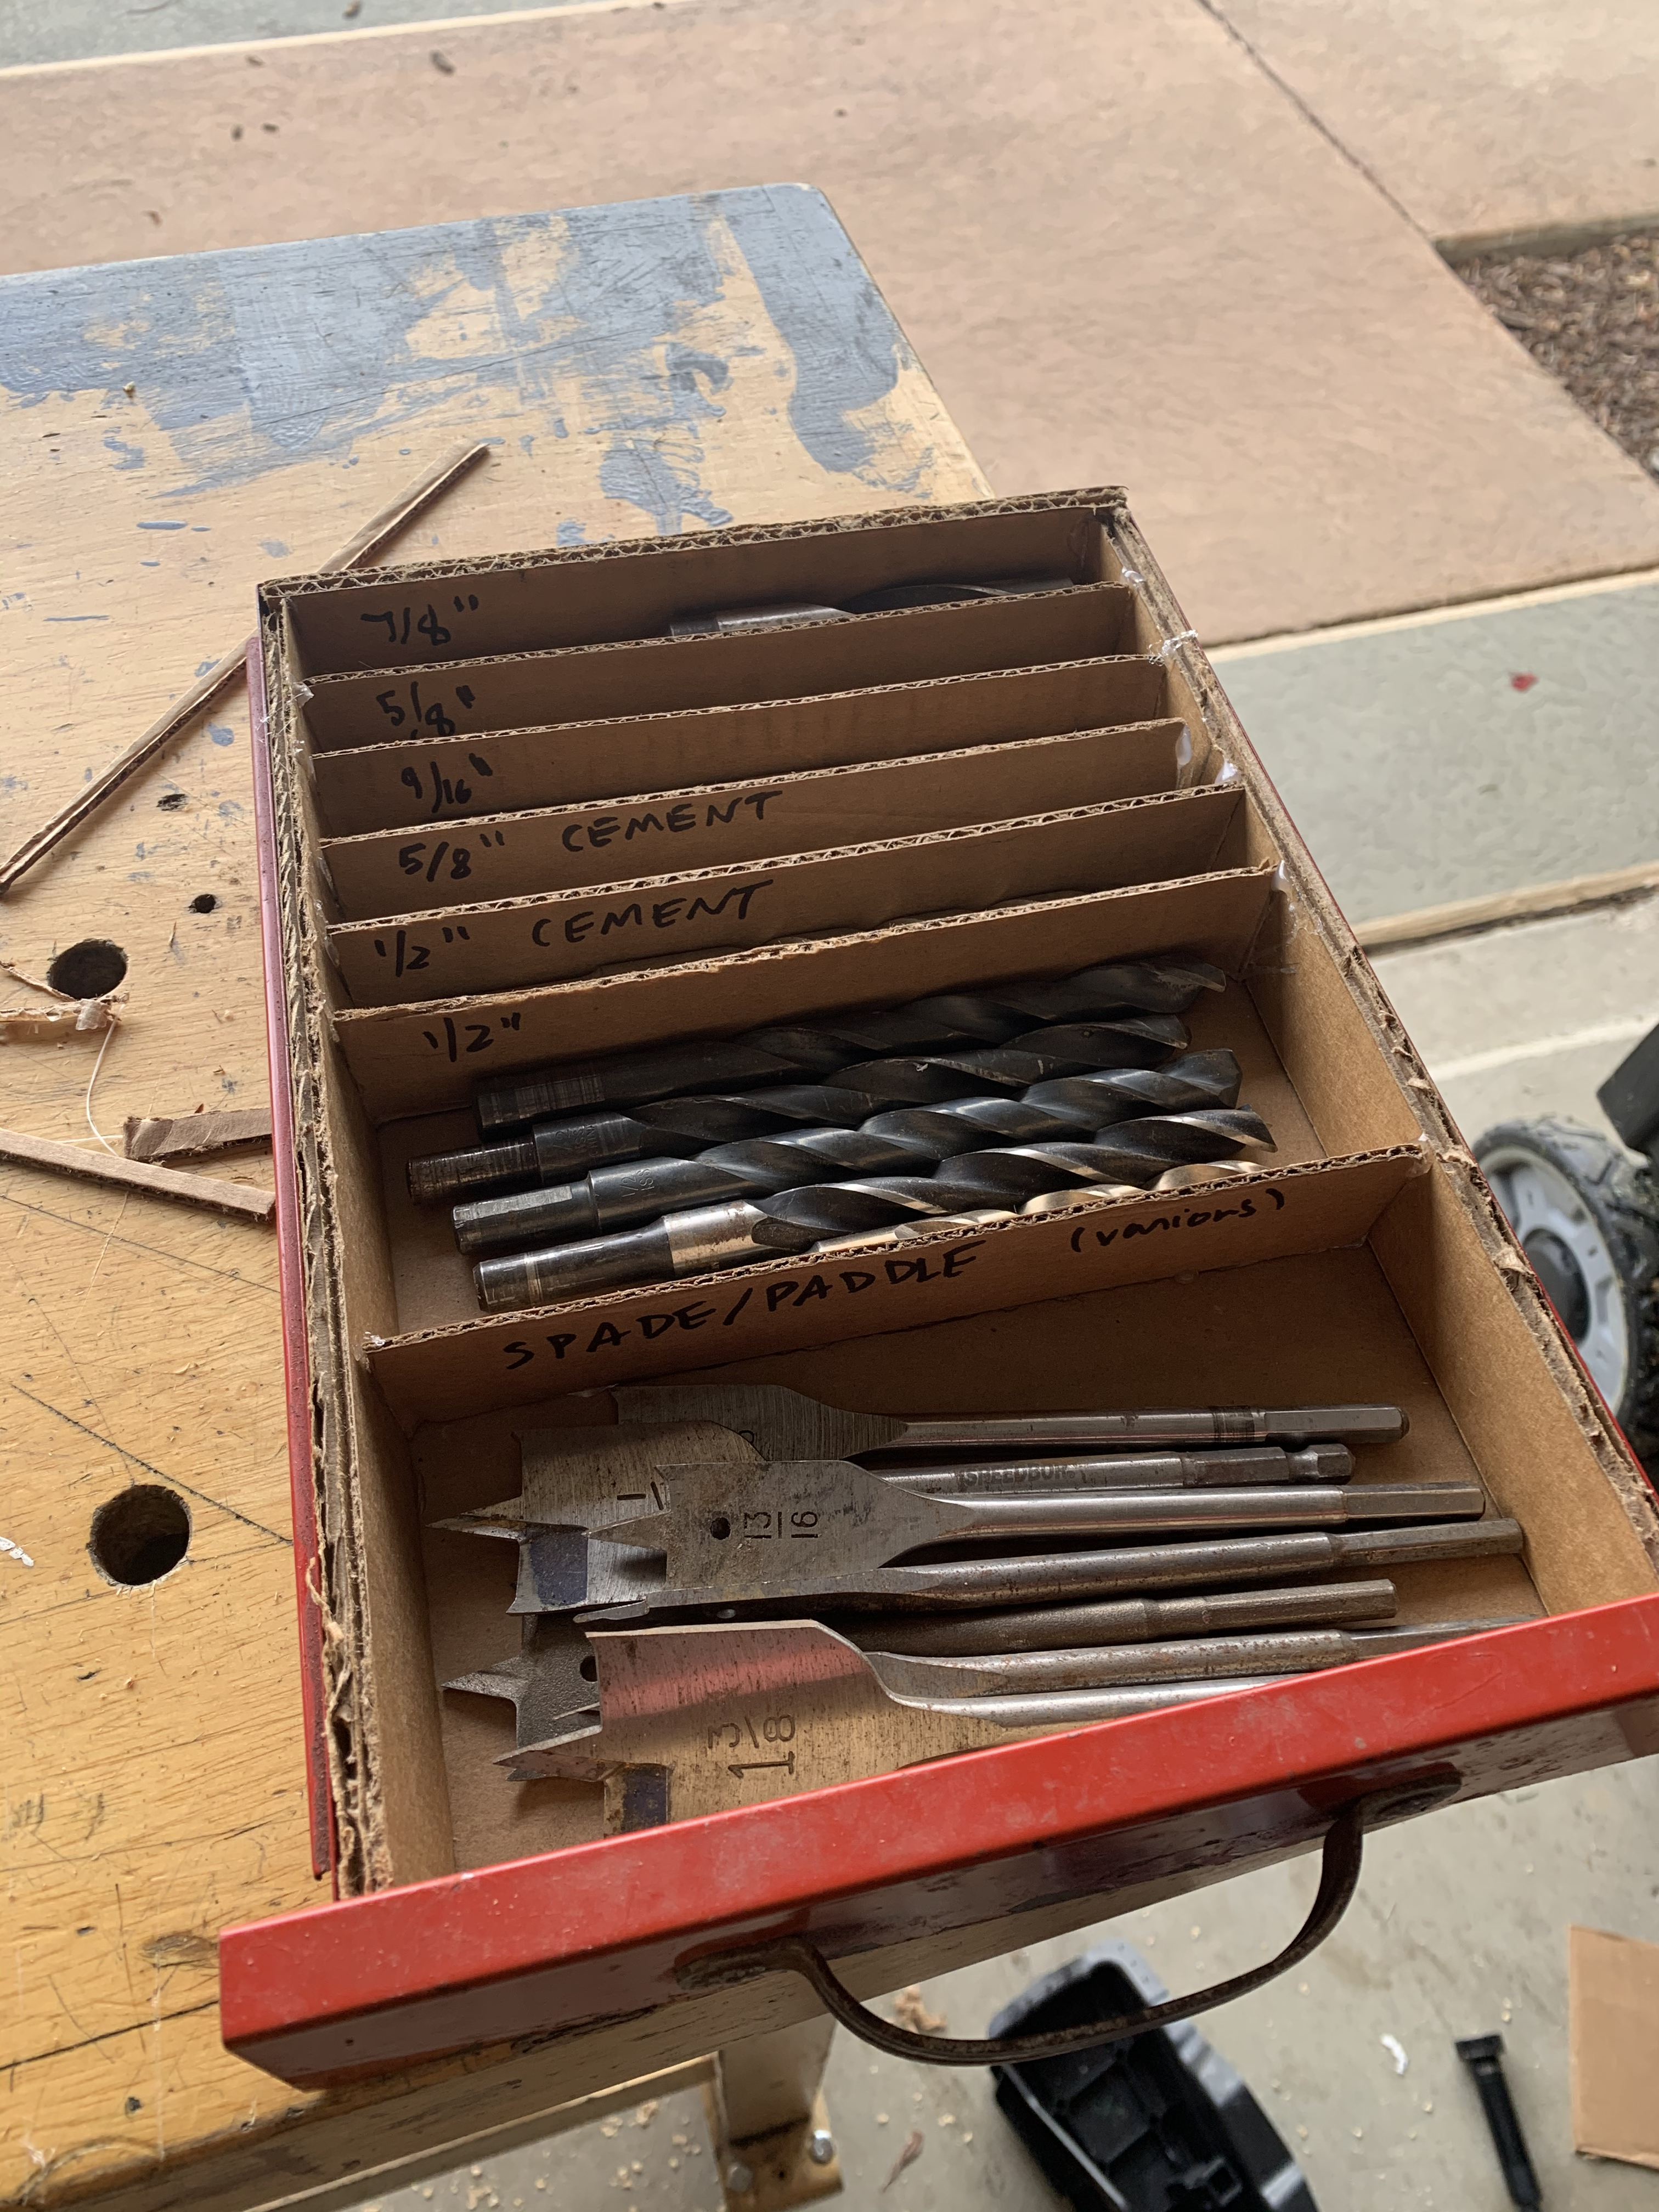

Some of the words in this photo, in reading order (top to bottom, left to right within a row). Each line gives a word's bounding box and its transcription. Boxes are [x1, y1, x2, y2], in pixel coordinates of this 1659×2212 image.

[361, 594, 479, 646] 7/8"
[376, 681, 476, 739] 5/8"
[398, 830, 505, 882] 5/8"
[561, 790, 783, 853] CEMENT
[374, 926, 471, 978] 1/2"
[531, 879, 775, 947] CEMENT
[423, 1012, 521, 1063] 1/2"
[619, 1176, 639, 1198] 1/2
[636, 1169, 657, 1198] HSS
